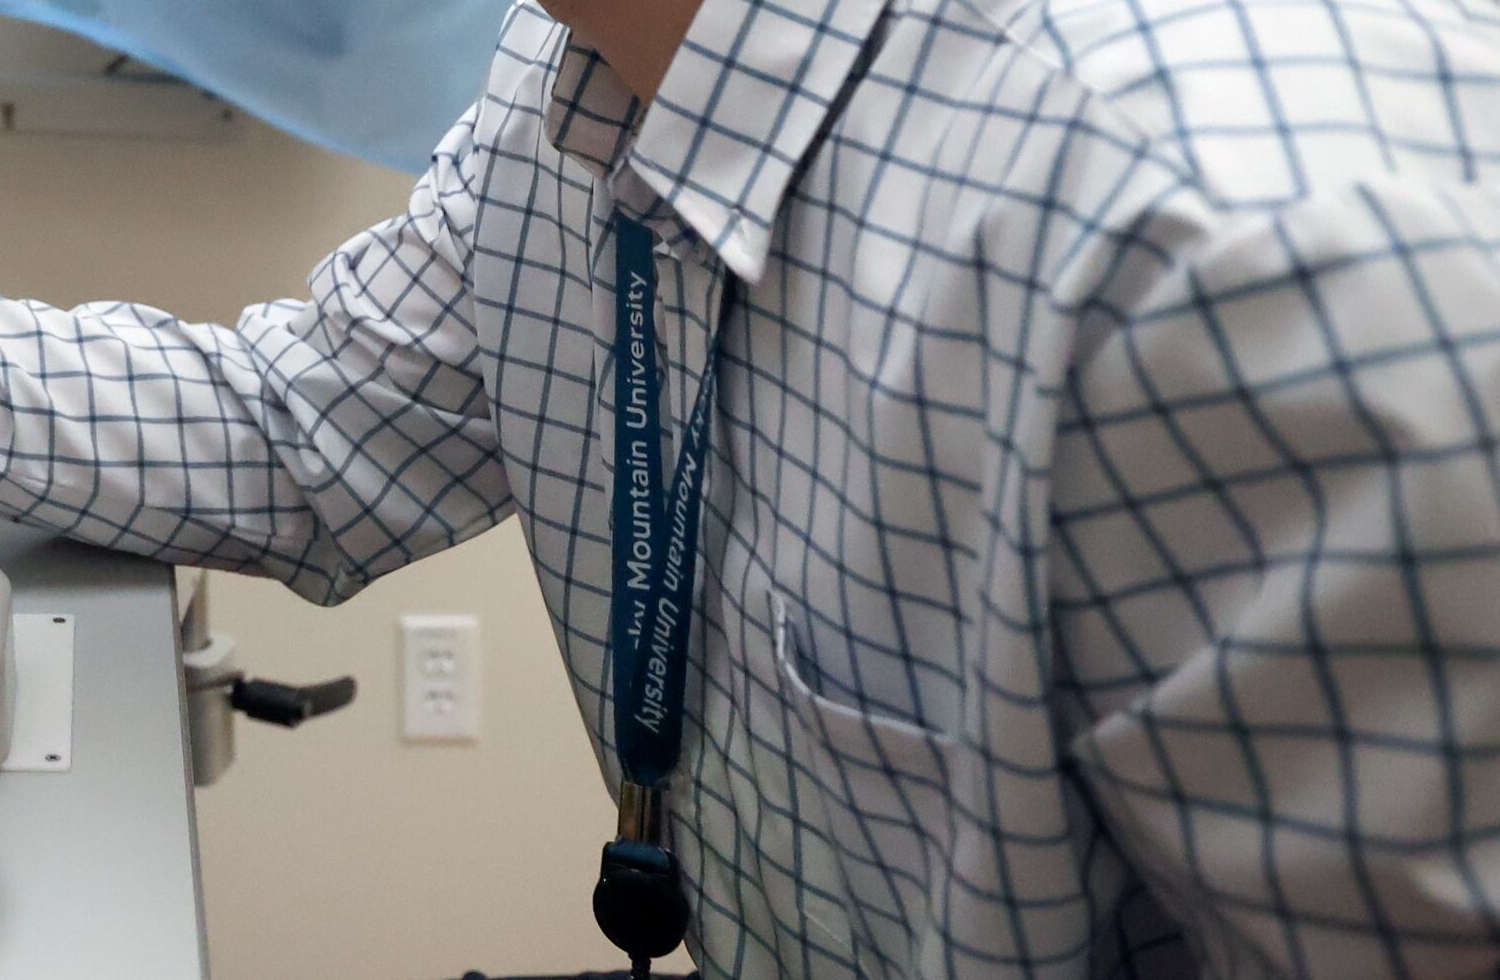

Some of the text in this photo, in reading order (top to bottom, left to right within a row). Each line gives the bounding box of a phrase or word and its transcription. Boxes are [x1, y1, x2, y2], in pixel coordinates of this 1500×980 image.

[626, 271, 648, 430] University
[626, 440, 651, 590] Mountain
[663, 452, 698, 592] Mountain
[634, 597, 680, 735] University
